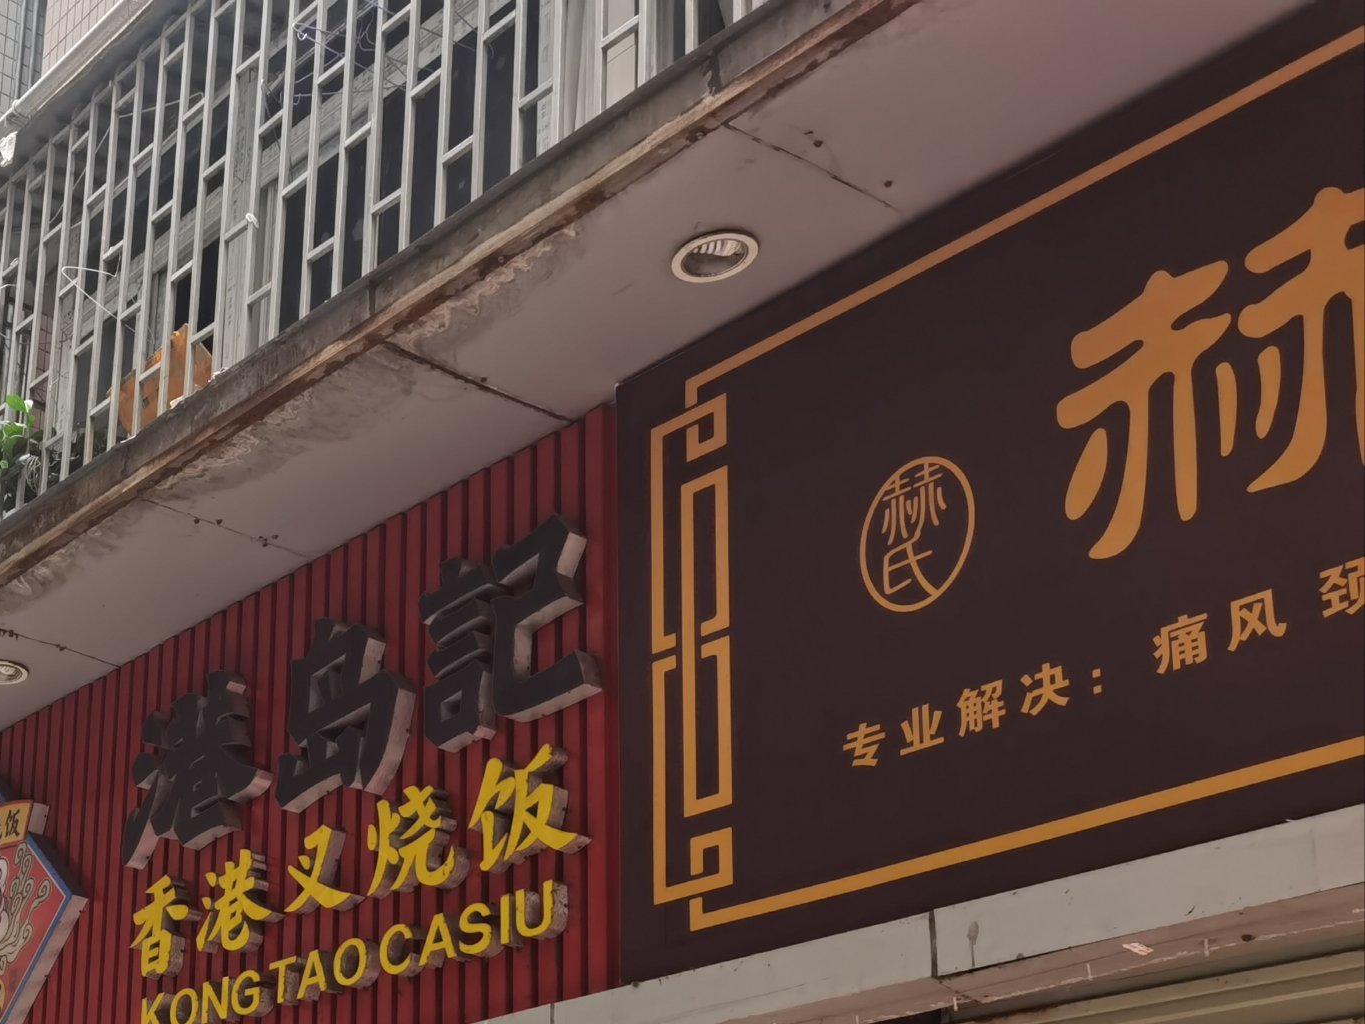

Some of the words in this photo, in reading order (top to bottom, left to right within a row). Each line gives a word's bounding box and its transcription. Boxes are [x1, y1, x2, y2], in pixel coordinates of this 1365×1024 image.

[124, 512, 602, 870] 港岛記
[131, 744, 578, 977] 香港叉烧饭
